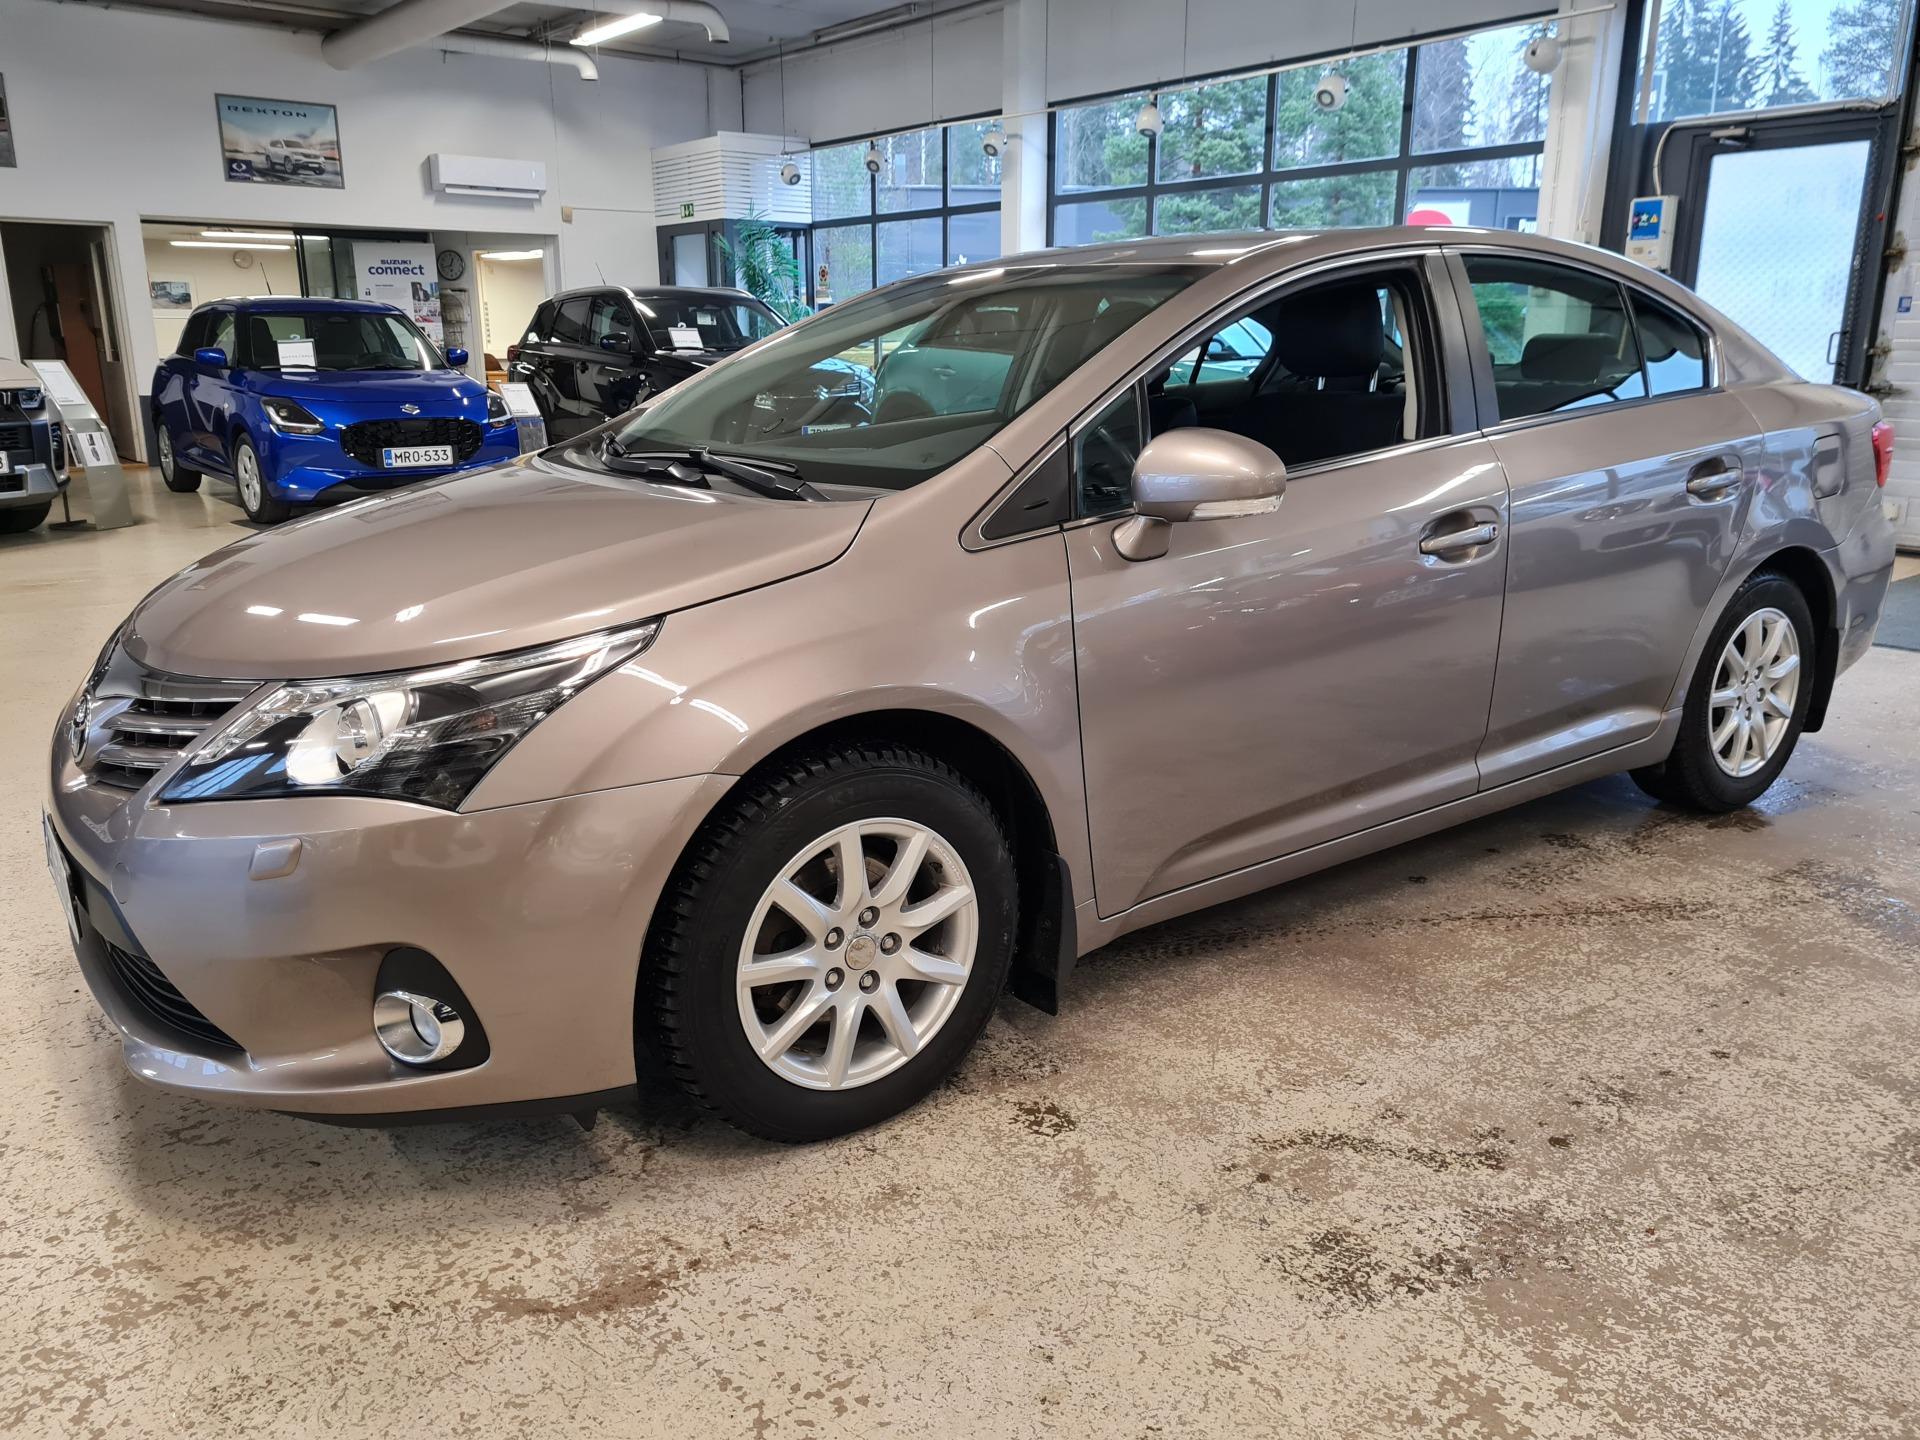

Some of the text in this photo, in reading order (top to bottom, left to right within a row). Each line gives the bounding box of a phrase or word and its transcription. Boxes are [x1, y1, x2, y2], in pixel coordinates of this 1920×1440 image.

[227, 105, 308, 118] REXTON
[368, 264, 425, 276] connect
[393, 449, 449, 463] MRO-533
